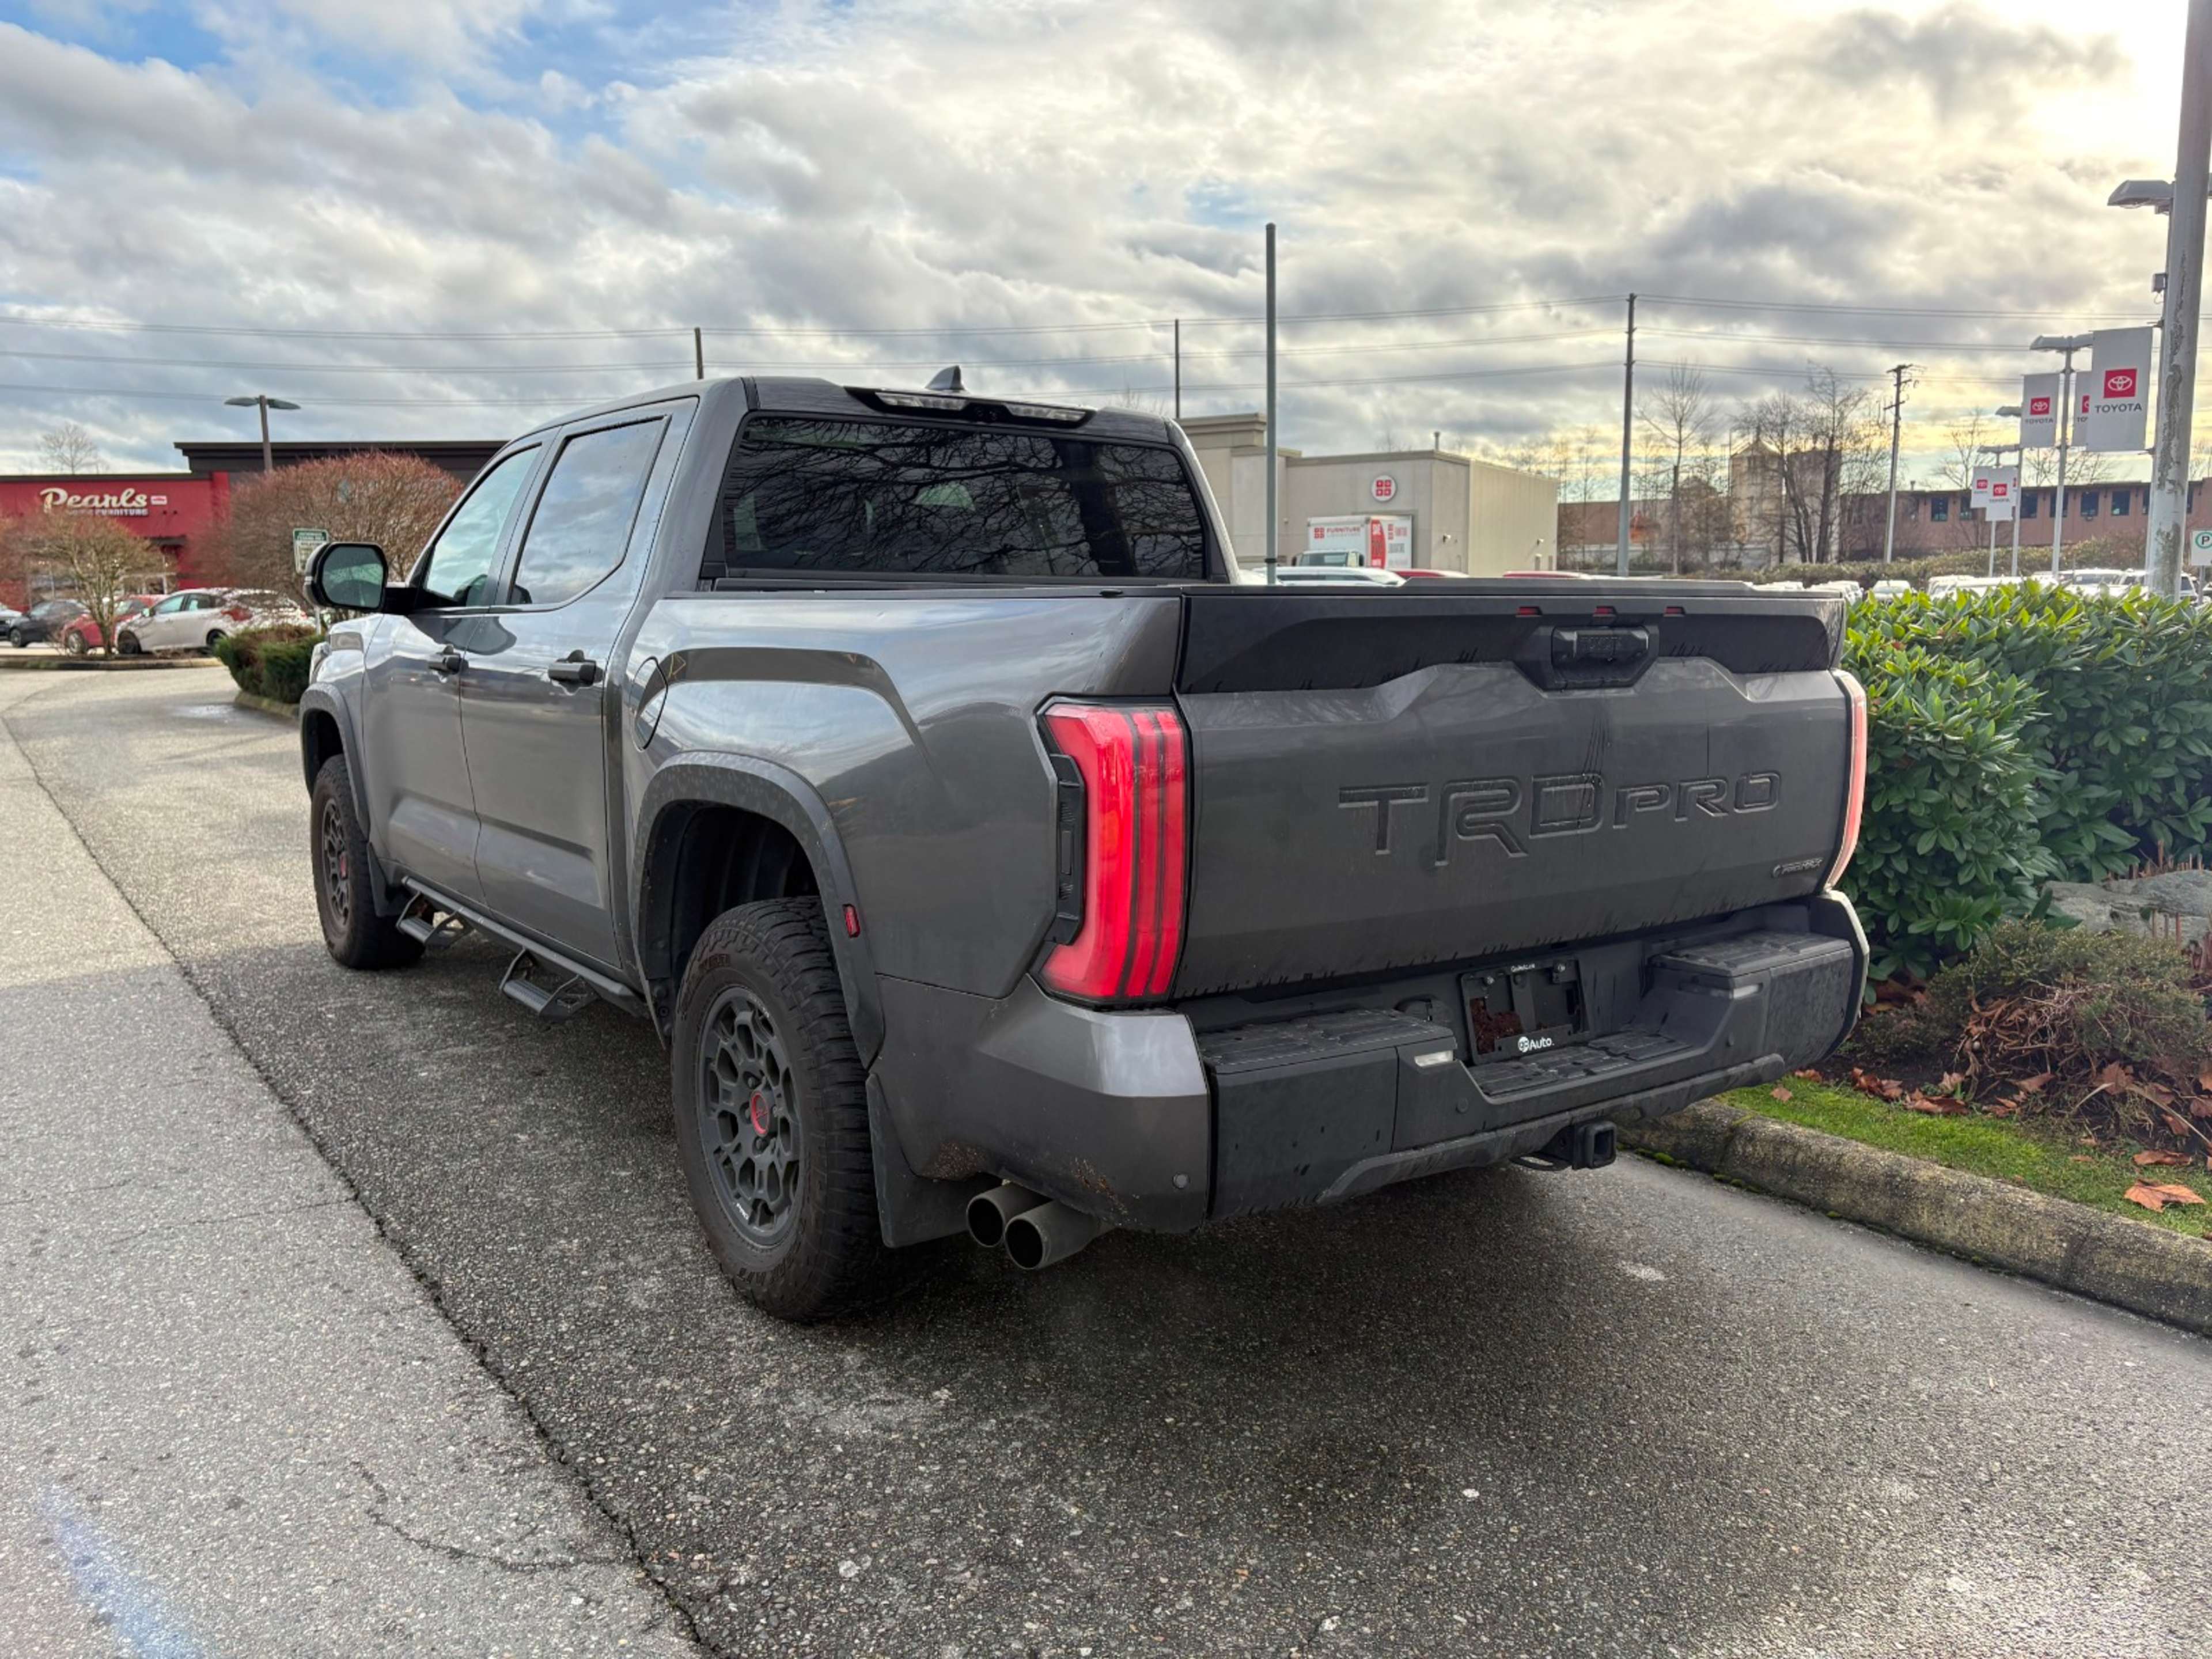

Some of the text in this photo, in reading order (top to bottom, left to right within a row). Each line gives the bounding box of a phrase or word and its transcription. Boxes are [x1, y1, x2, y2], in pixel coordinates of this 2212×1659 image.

[2095, 403, 2142, 414] TOYOTA
[40, 487, 147, 514] Pearls
[2202, 536, 2210, 545] P
[1338, 771, 1779, 866] TRD PRO
